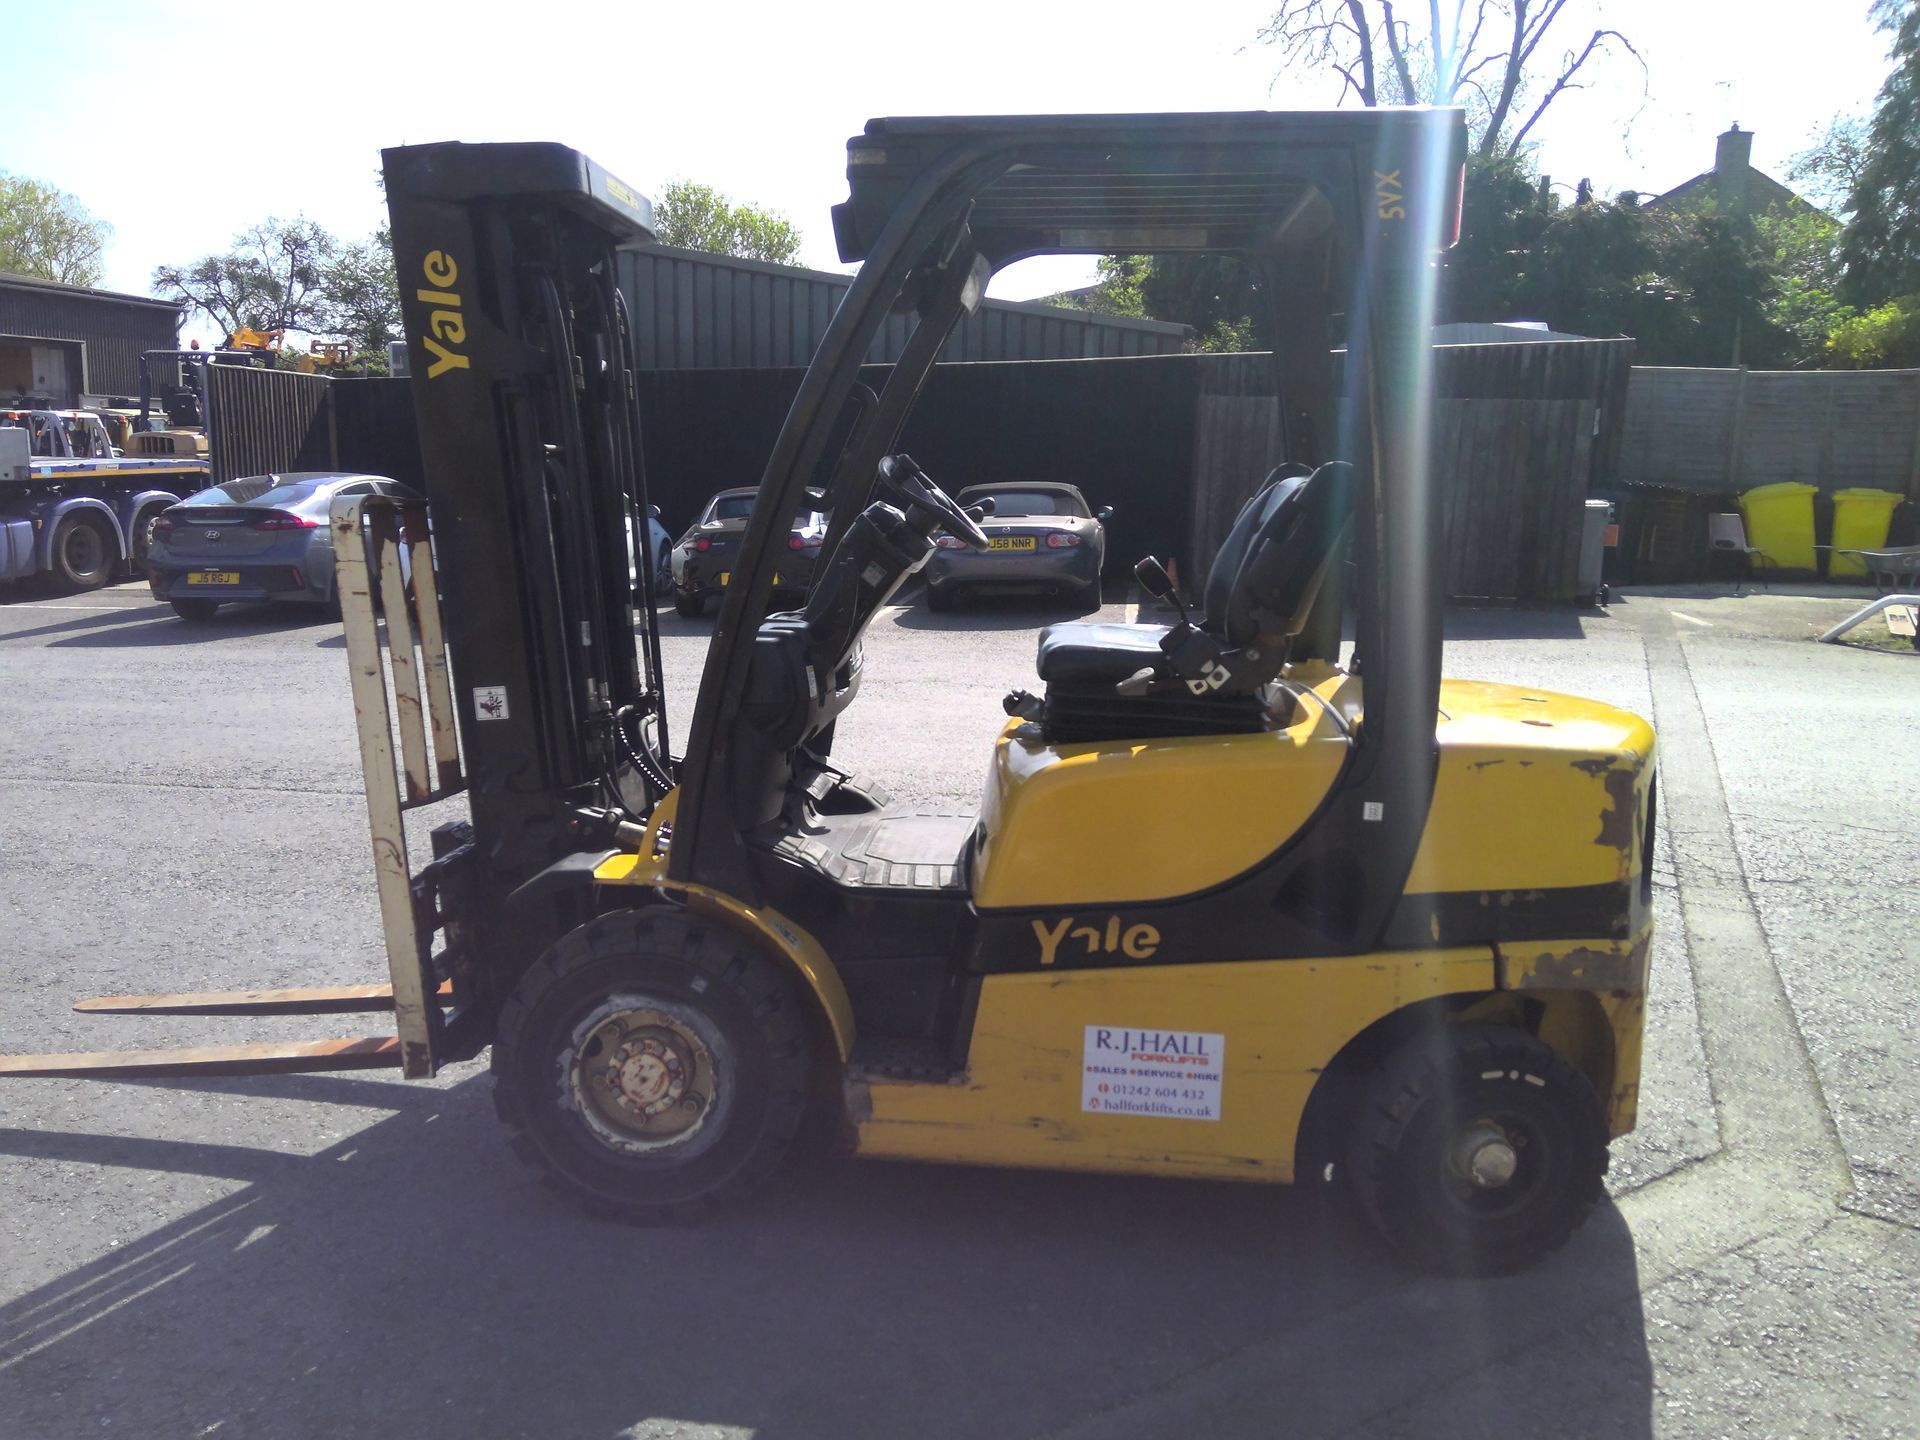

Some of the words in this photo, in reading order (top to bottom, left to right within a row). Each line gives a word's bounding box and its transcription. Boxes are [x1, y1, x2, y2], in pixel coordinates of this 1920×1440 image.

[416, 249, 470, 379] Yale
[988, 538, 1009, 549] J58
[1012, 538, 1031, 548] NNR
[1131, 1053, 1209, 1066] FORKLIFTS
[1093, 1066, 1127, 1075] SALES
[1137, 1070, 1184, 1079] SERVICE
[1193, 1073, 1219, 1082] HIRE
[1113, 1084, 1151, 1096] 01242
[1155, 1088, 1177, 1098] 604
[1182, 1090, 1205, 1100] 432
[1104, 1099, 1212, 1117] hallforklifts.co.uk
